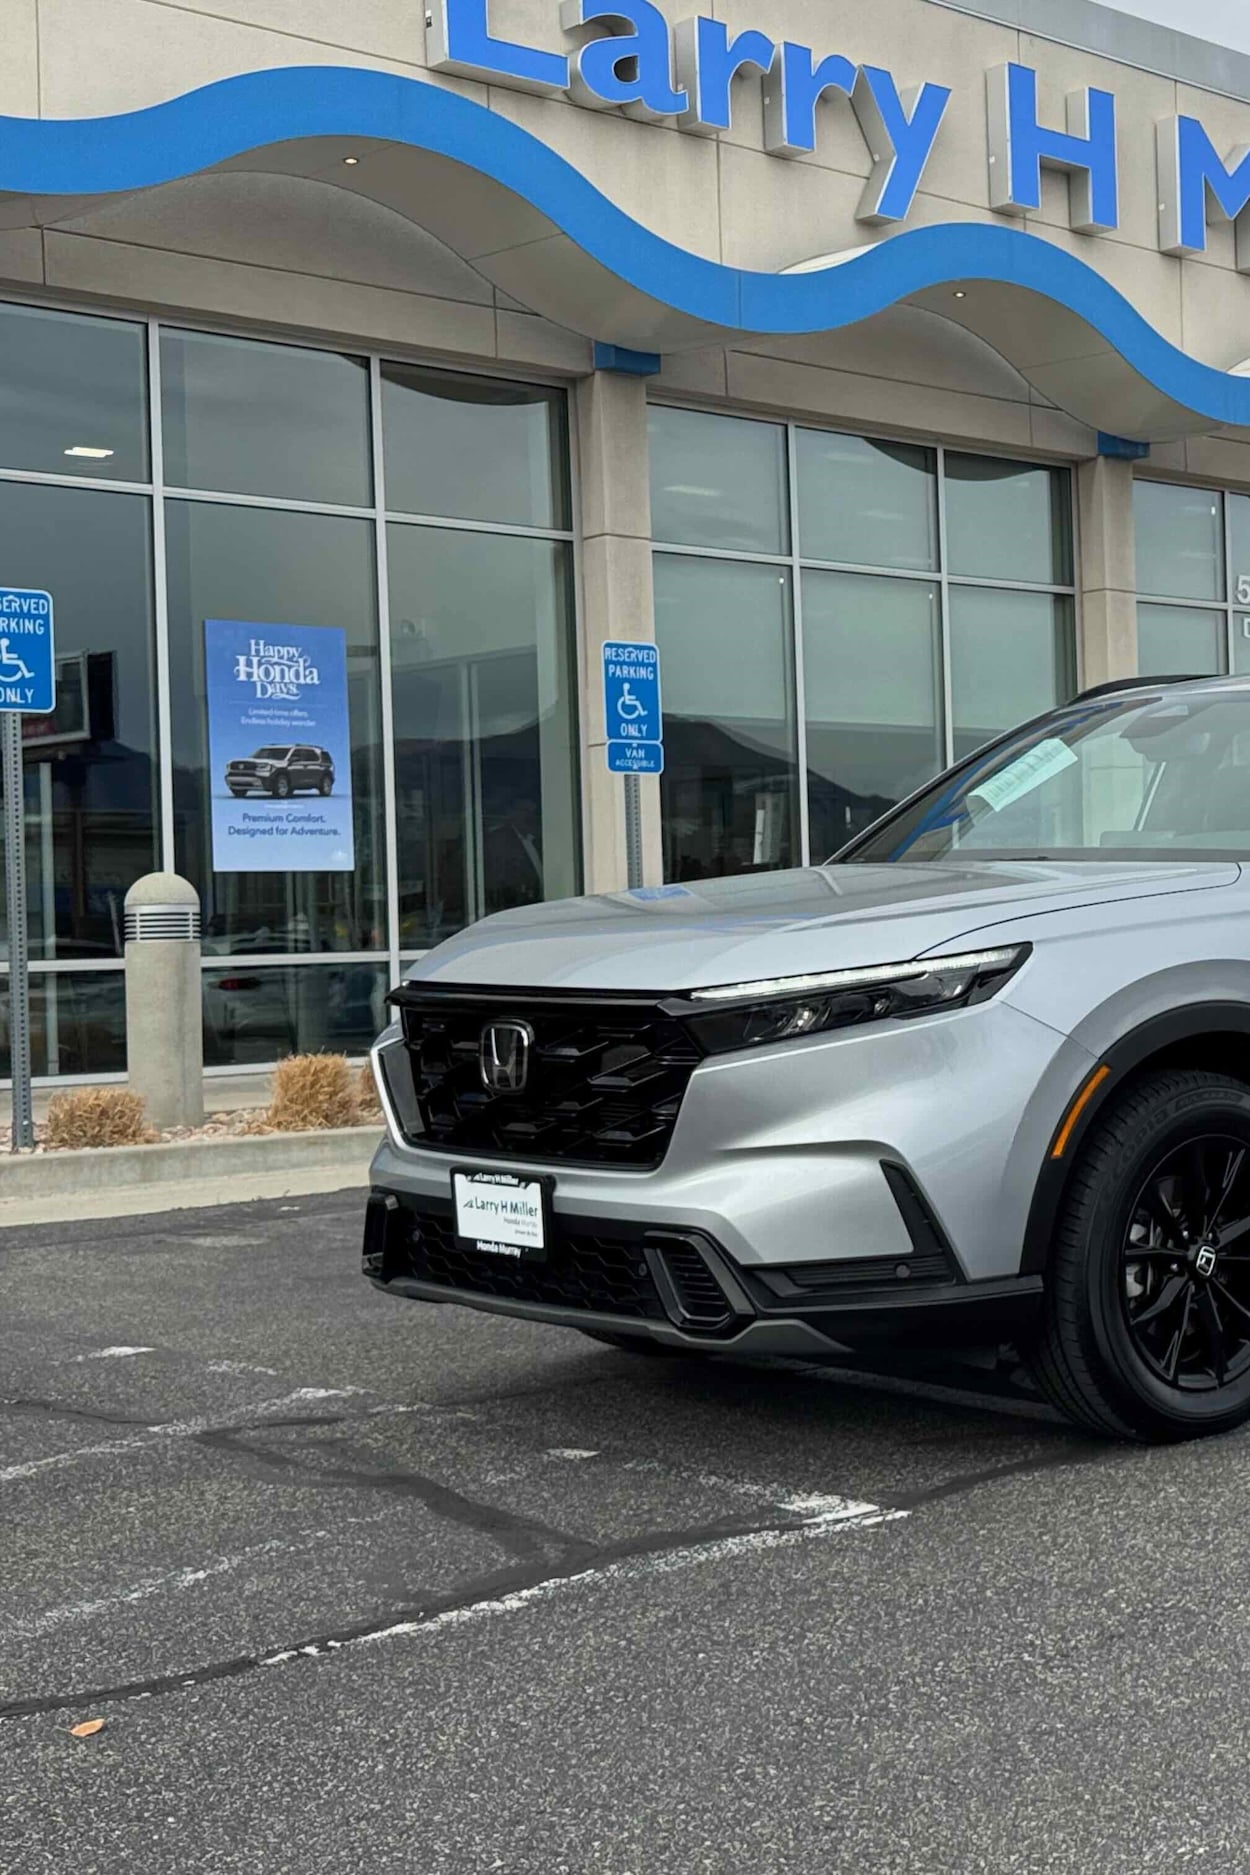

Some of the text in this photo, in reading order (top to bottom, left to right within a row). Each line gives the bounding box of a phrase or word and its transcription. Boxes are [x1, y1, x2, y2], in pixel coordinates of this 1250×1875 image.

[1003, 61, 1119, 231] H
[249, 639, 302, 662] Happy
[604, 647, 656, 663] RESERVED
[233, 654, 320, 685] Honda
[608, 664, 654, 681] PARKING
[620, 723, 648, 738] ONLY
[625, 747, 646, 759] VAN
[242, 813, 284, 824] Premium
[228, 825, 341, 838] Designed for Adventure.
[475, 1195, 538, 1217] Larry H Miller
